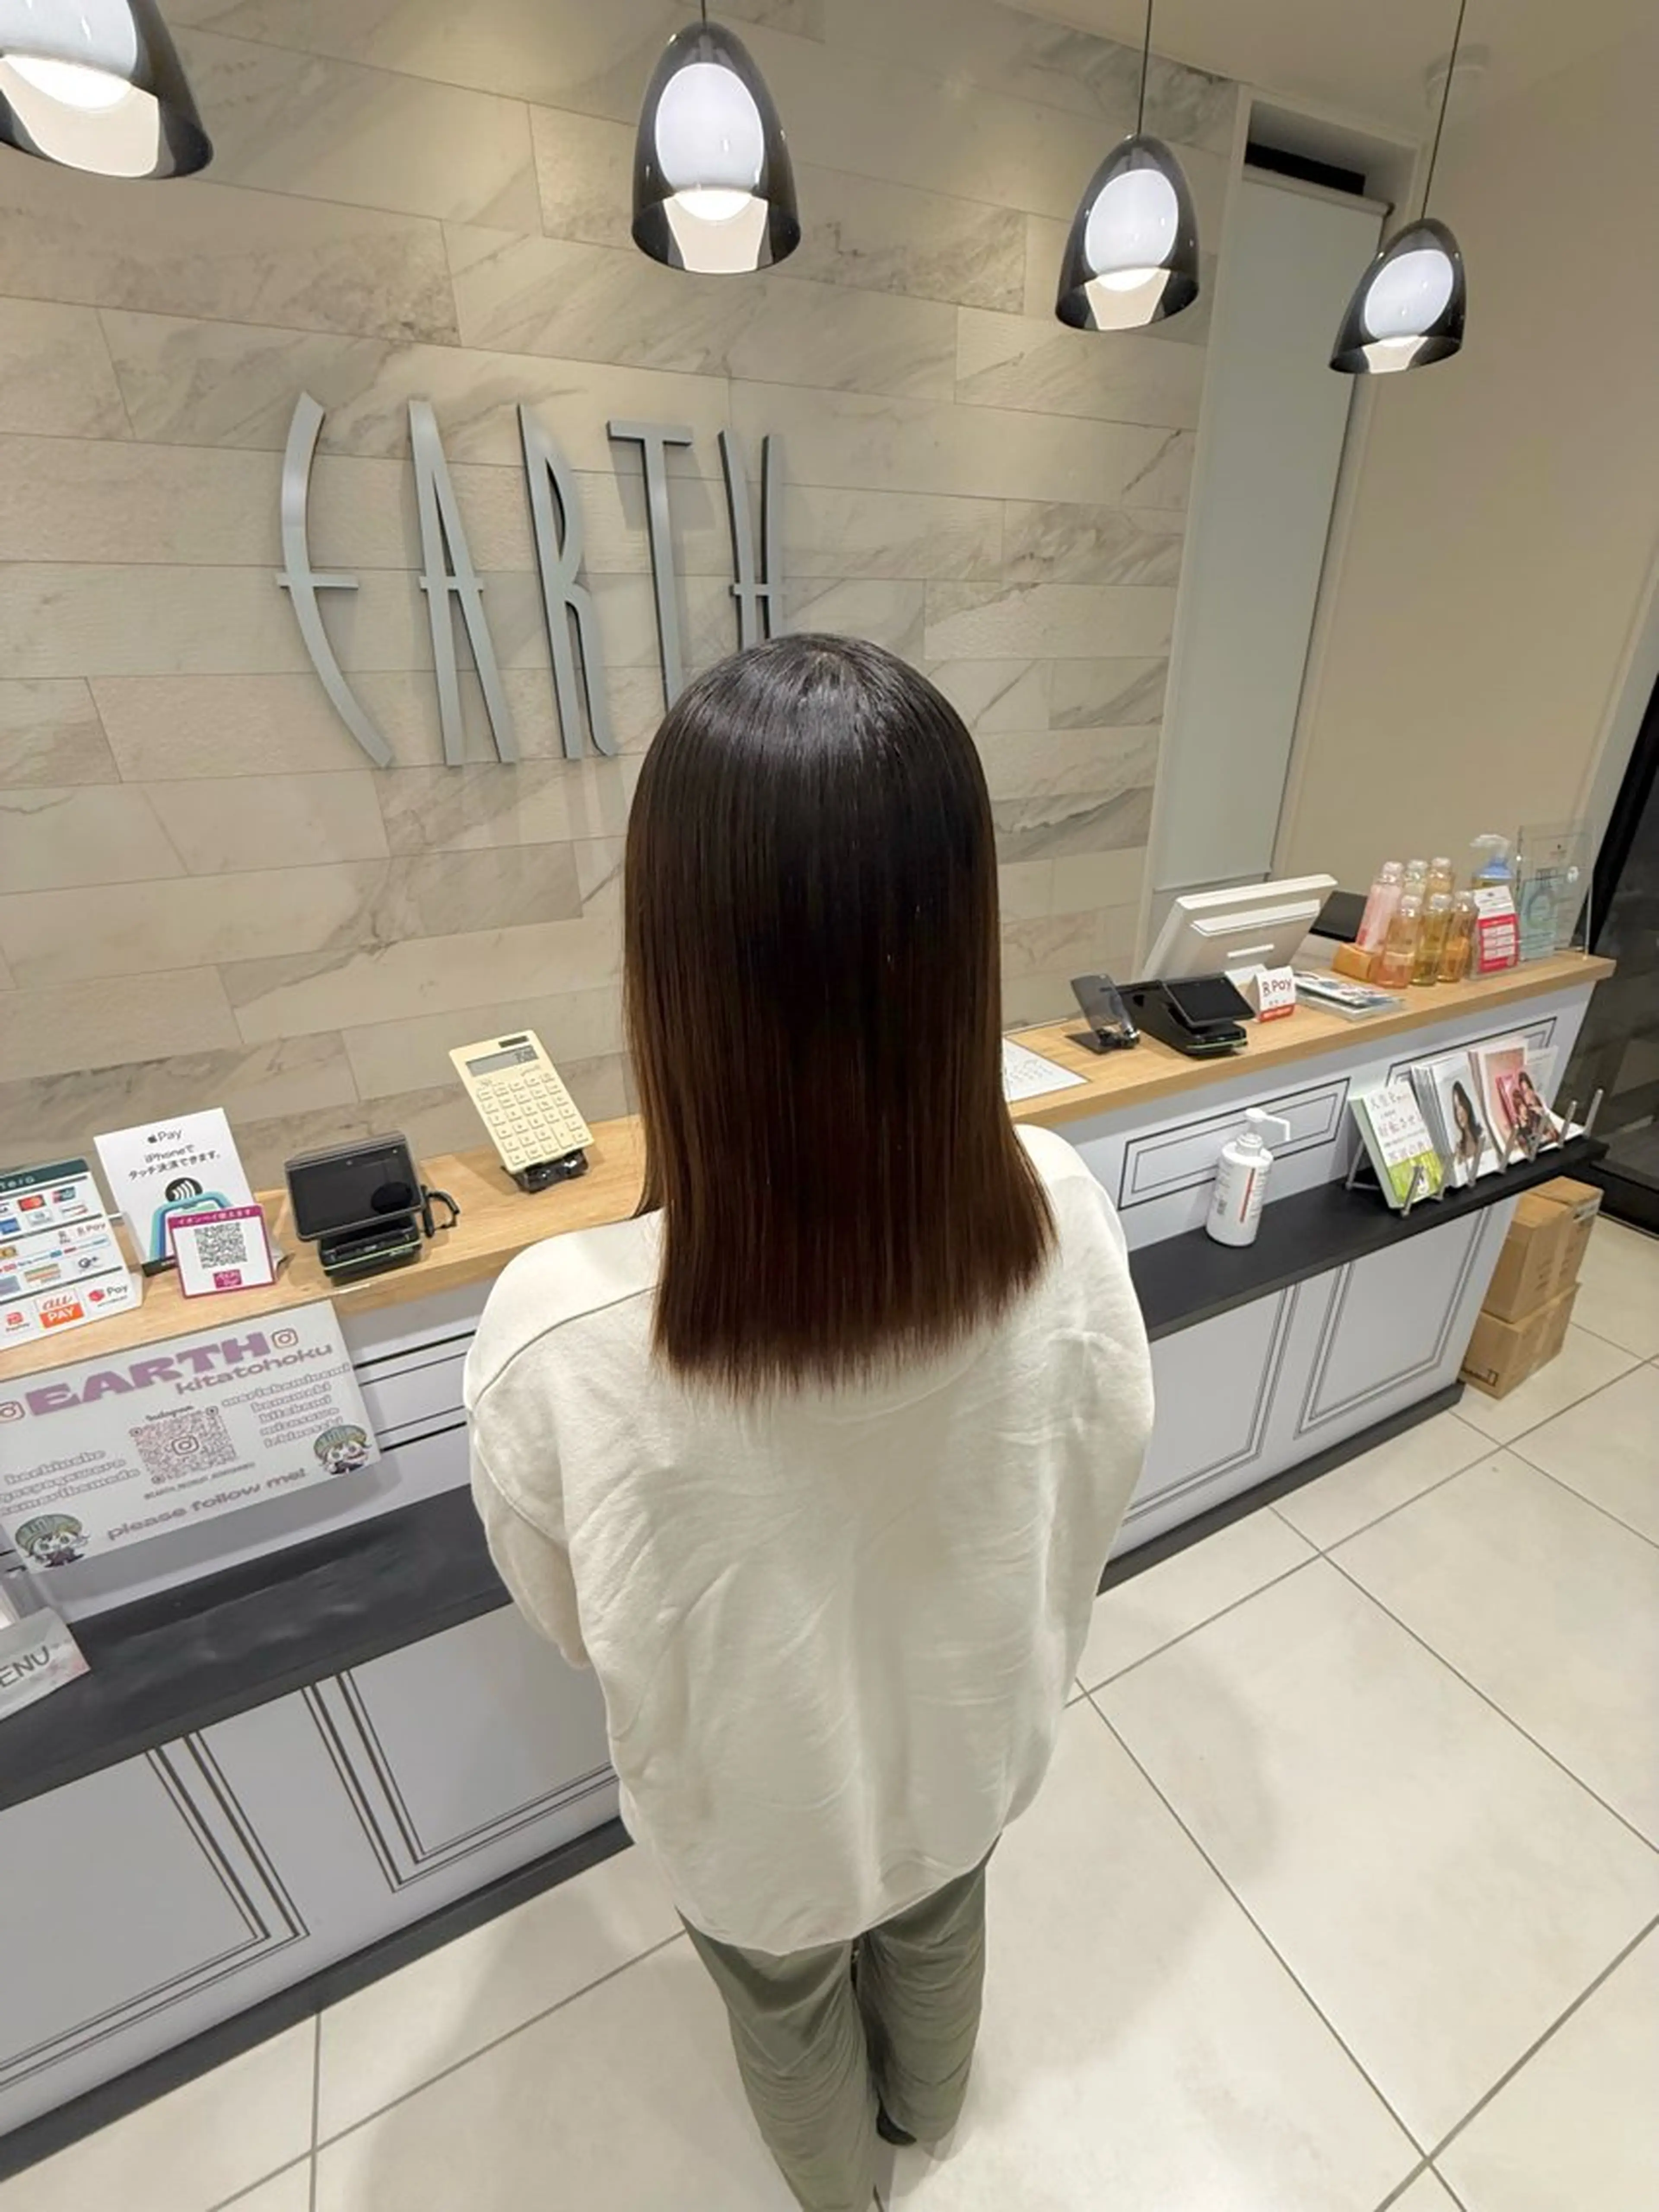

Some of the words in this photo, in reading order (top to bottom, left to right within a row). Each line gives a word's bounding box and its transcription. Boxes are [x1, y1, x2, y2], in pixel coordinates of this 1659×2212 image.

[277, 391, 784, 768] EARTH
[157, 1129, 182, 1141] Pay
[47, 1306, 75, 1322] PAY
[25, 1332, 271, 1416] EARTH
[176, 1344, 333, 1395] kitatohoku
[107, 1507, 187, 1541] please
[191, 1483, 261, 1512] follow
[0, 1646, 50, 1688] ENU
